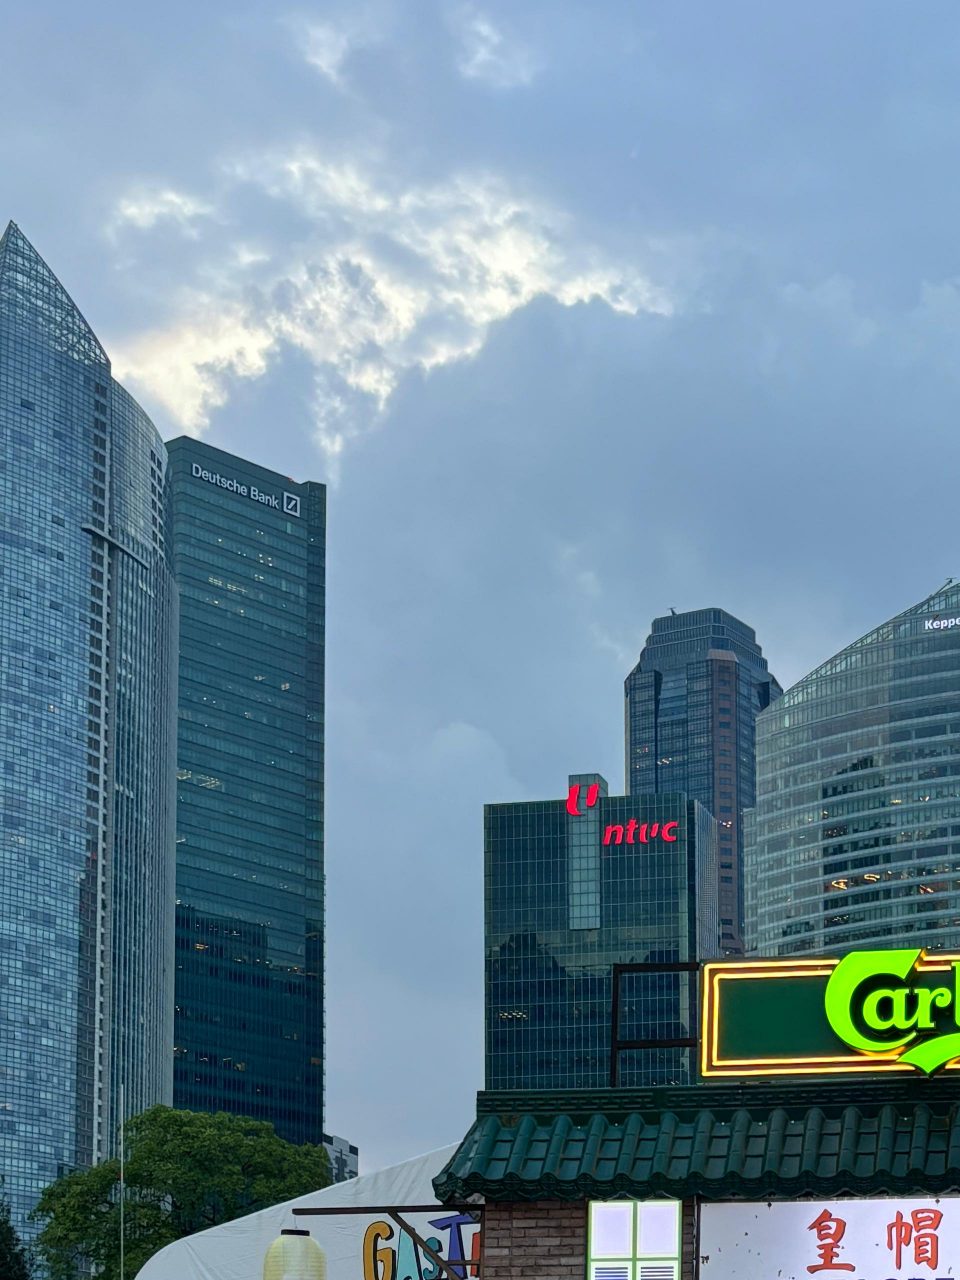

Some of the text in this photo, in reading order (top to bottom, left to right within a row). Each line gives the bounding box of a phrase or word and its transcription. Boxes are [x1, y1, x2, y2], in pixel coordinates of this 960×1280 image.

[192, 463, 279, 509] Deutsche Bank
[603, 818, 678, 845] ntuc
